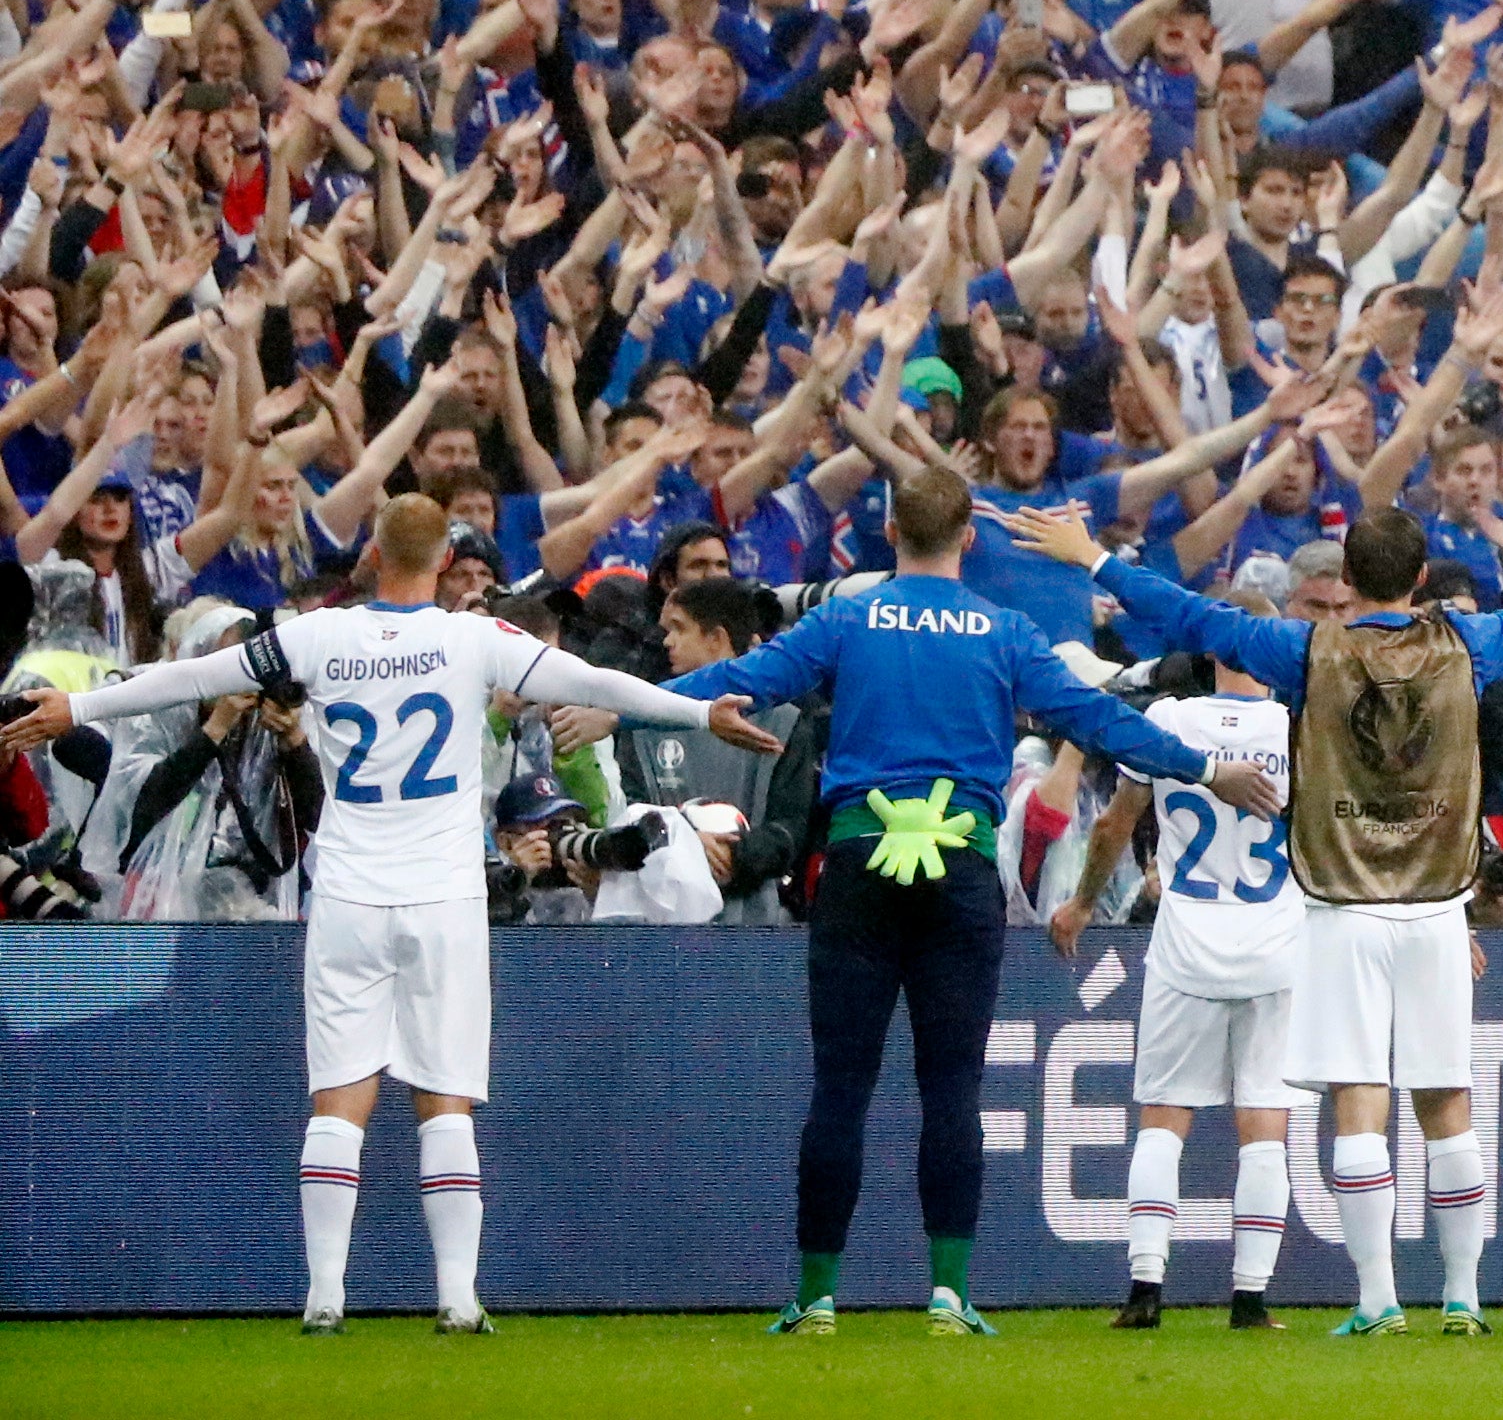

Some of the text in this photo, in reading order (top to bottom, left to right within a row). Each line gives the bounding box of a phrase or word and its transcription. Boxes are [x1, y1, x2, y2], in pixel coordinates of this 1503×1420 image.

[866, 596, 992, 636] ÍSLAND
[325, 646, 449, 683] GUÐJOHNSEN
[324, 691, 459, 804] 22
[1164, 790, 1290, 904] 23
[1363, 823, 1420, 836] FRANCE
